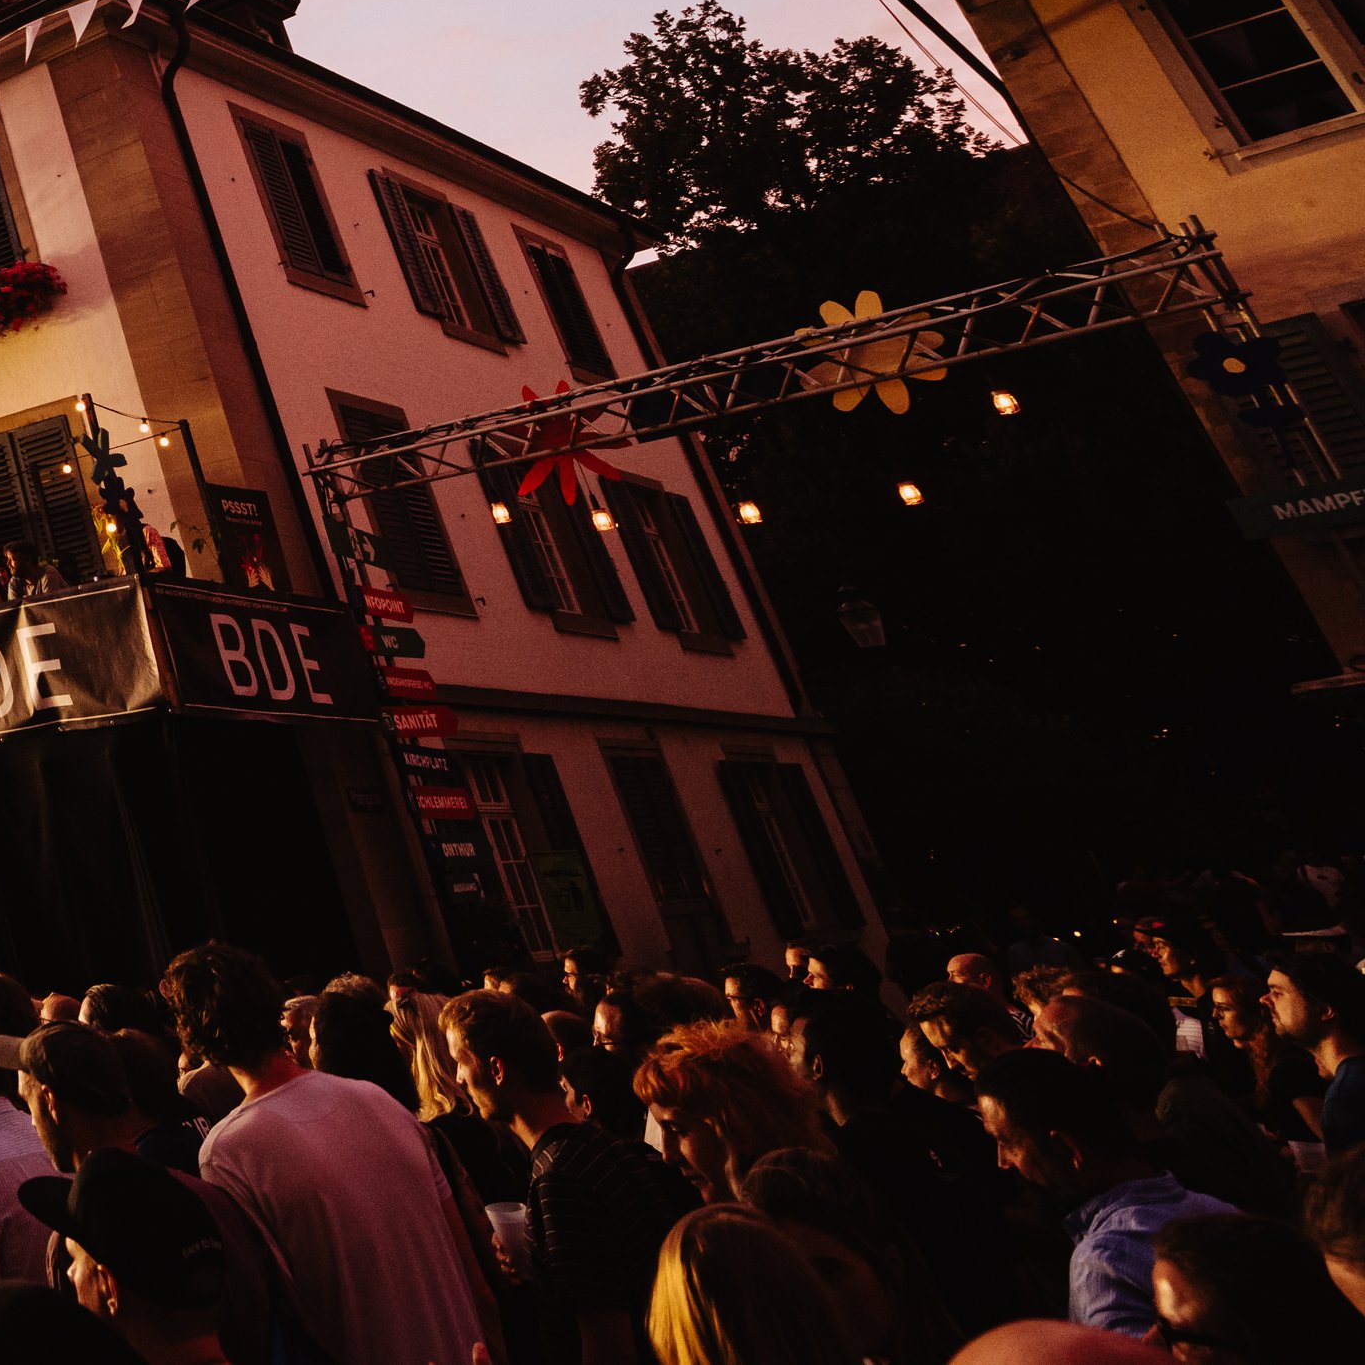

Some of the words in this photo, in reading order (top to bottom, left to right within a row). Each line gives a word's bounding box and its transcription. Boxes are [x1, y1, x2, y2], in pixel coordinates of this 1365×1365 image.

[220, 498, 258, 517] PSSST!
[363, 594, 406, 614] NFOPOINT
[381, 634, 399, 650] WC
[211, 612, 334, 706] BDE
[393, 710, 439, 731] SANITÄT
[403, 752, 450, 771] KIRCHPLATZ
